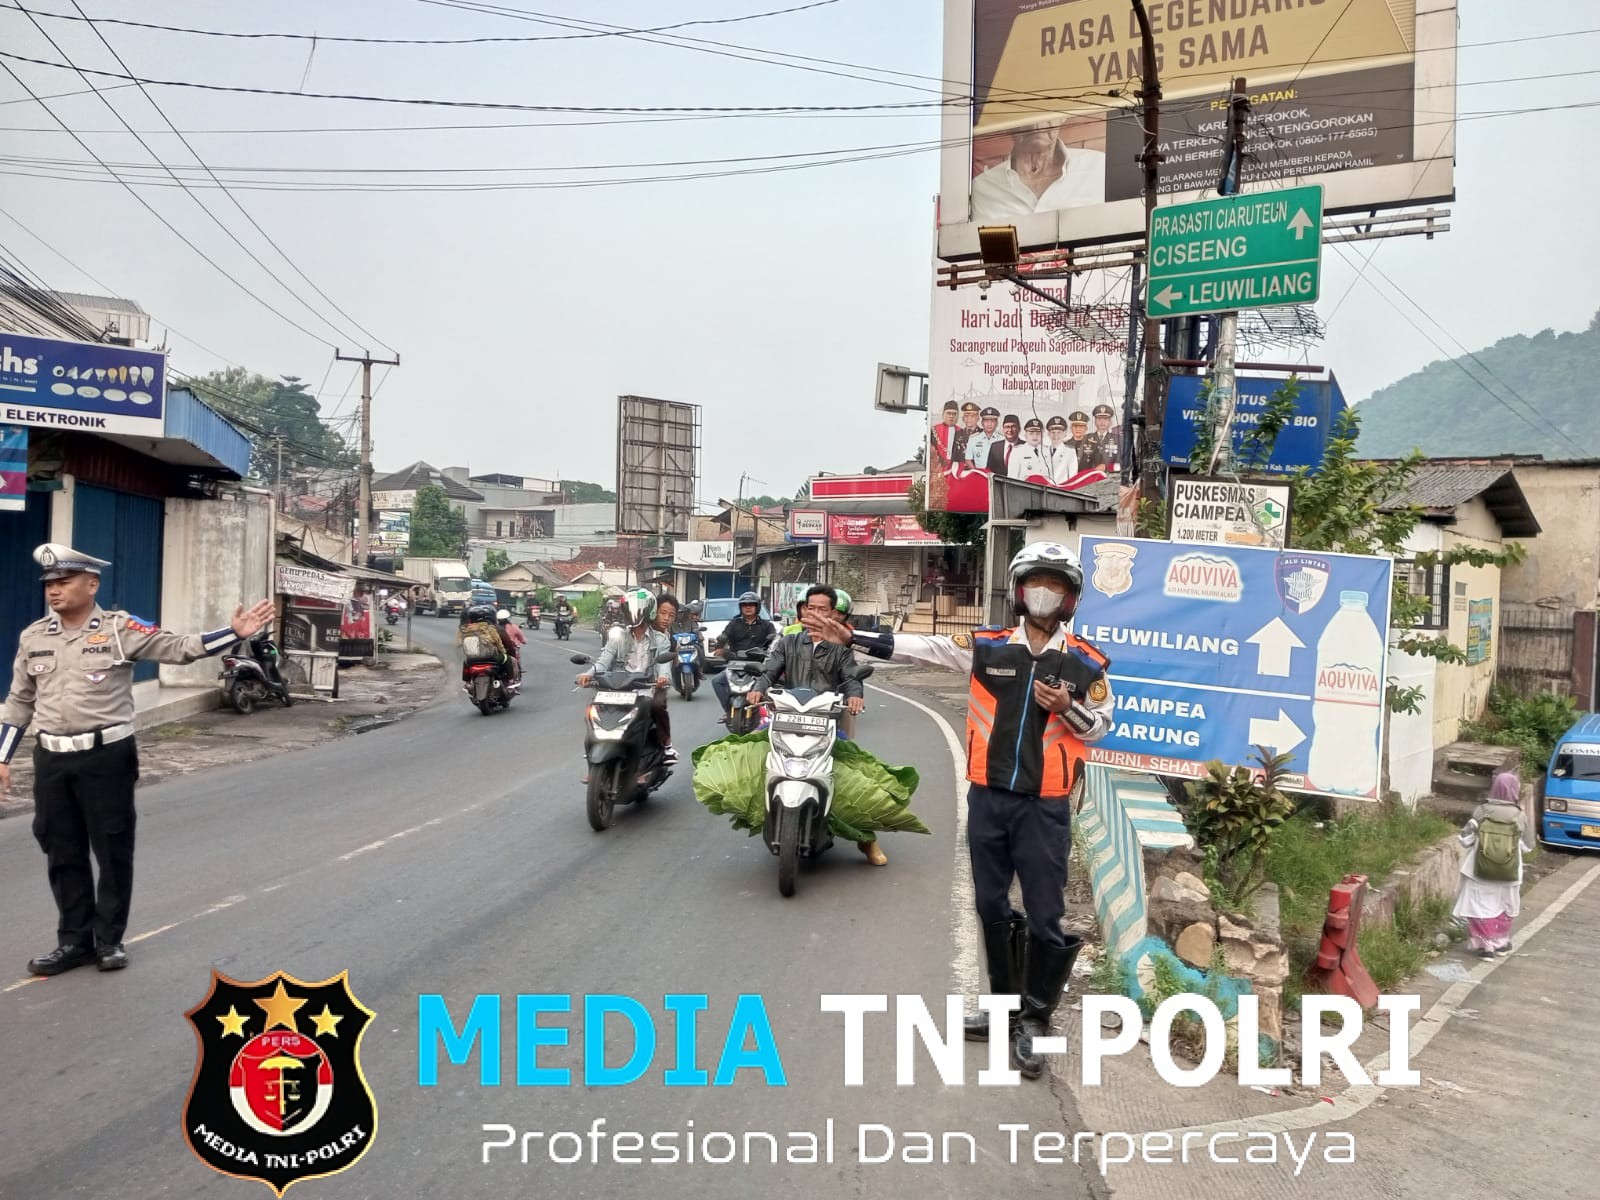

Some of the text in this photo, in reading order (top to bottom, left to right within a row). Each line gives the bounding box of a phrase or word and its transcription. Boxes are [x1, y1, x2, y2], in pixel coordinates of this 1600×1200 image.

[1041, 14, 1115, 57] RASA
[1179, 24, 1268, 69] SAMA
[1278, 113, 1373, 135] TENGGOROKAN
[1160, 169, 1203, 184] DILARANG
[1270, 156, 1312, 169] MEMBERI
[1315, 150, 1353, 163] KEPADA
[1173, 184, 1182, 192] DI
[1185, 180, 1216, 190] BAWAH
[1262, 170, 1281, 180] DAN
[1284, 162, 1343, 177] PEREMPUAN
[1345, 157, 1374, 168] HAMIL
[1154, 201, 1288, 237] PRASASTI CIARUTEUN
[1153, 236, 1247, 267] CISEENG
[1189, 272, 1312, 305] LEUWILIANG
[961, 308, 990, 329] Hari
[994, 308, 1023, 329] Jadi
[950, 338, 1008, 355] Sacangreud
[1011, 338, 1046, 355] Pageuh
[984, 362, 1095, 377] Ngarojong Pangwangunan
[1002, 378, 1077, 393] Kabupaten Bogor
[6, 408, 106, 428] ELEKTRONIK
[1294, 416, 1318, 428] BIO
[1176, 484, 1255, 504] PUSKESMAS
[1174, 503, 1246, 522] CIAMPEA
[1177, 528, 1195, 540] 1.200
[1196, 529, 1218, 541] METER
[1168, 564, 1238, 589] AQUVIVA
[82, 646, 111, 655] POLRI
[1081, 623, 1239, 657] LEUWILIANG
[1318, 670, 1378, 692] AQUVIVA
[1111, 694, 1206, 720] IAMPEA
